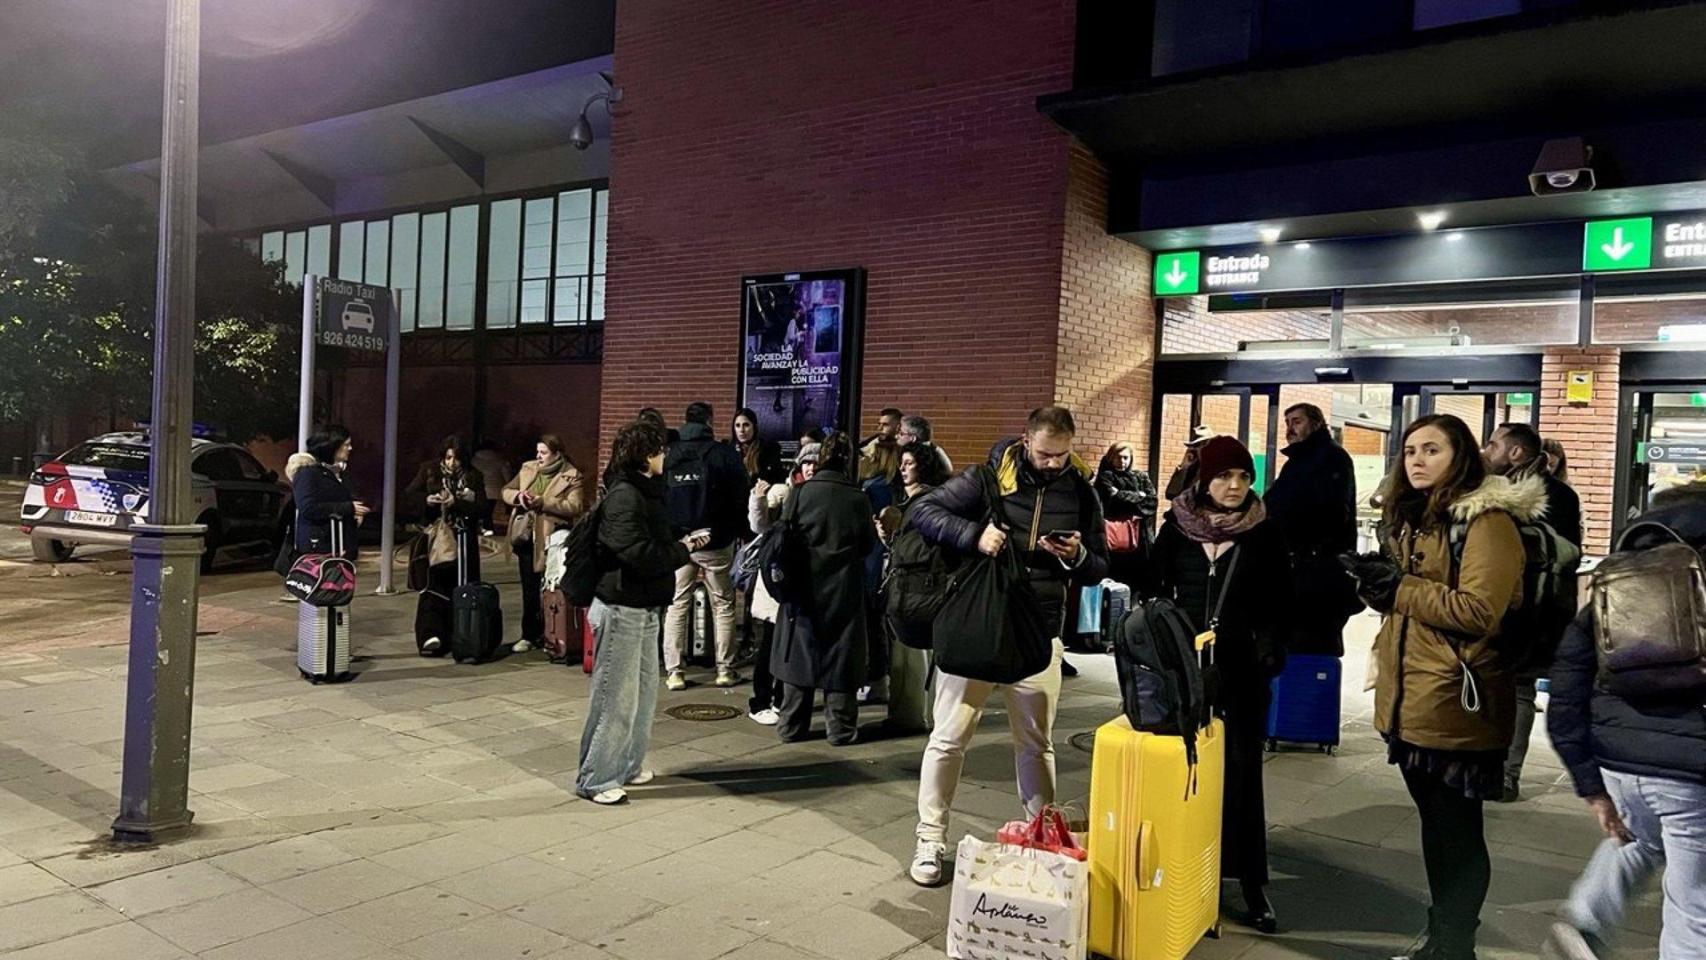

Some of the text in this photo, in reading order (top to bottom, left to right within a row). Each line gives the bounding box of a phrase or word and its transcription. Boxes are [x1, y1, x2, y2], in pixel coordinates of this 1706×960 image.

[1208, 254, 1270, 272] Entrada
[1207, 272, 1259, 286] ENTRANCE
[323, 280, 376, 299] Radio Taxi
[323, 331, 383, 350] 926 424 519
[781, 344, 793, 352] LA
[753, 353, 793, 362] SOCIEDAD
[761, 361, 792, 369] AVANZA
[792, 360, 797, 368] Y
[791, 366, 839, 376] PUBLICIDAD
[791, 375, 828, 384] CON ELLA
